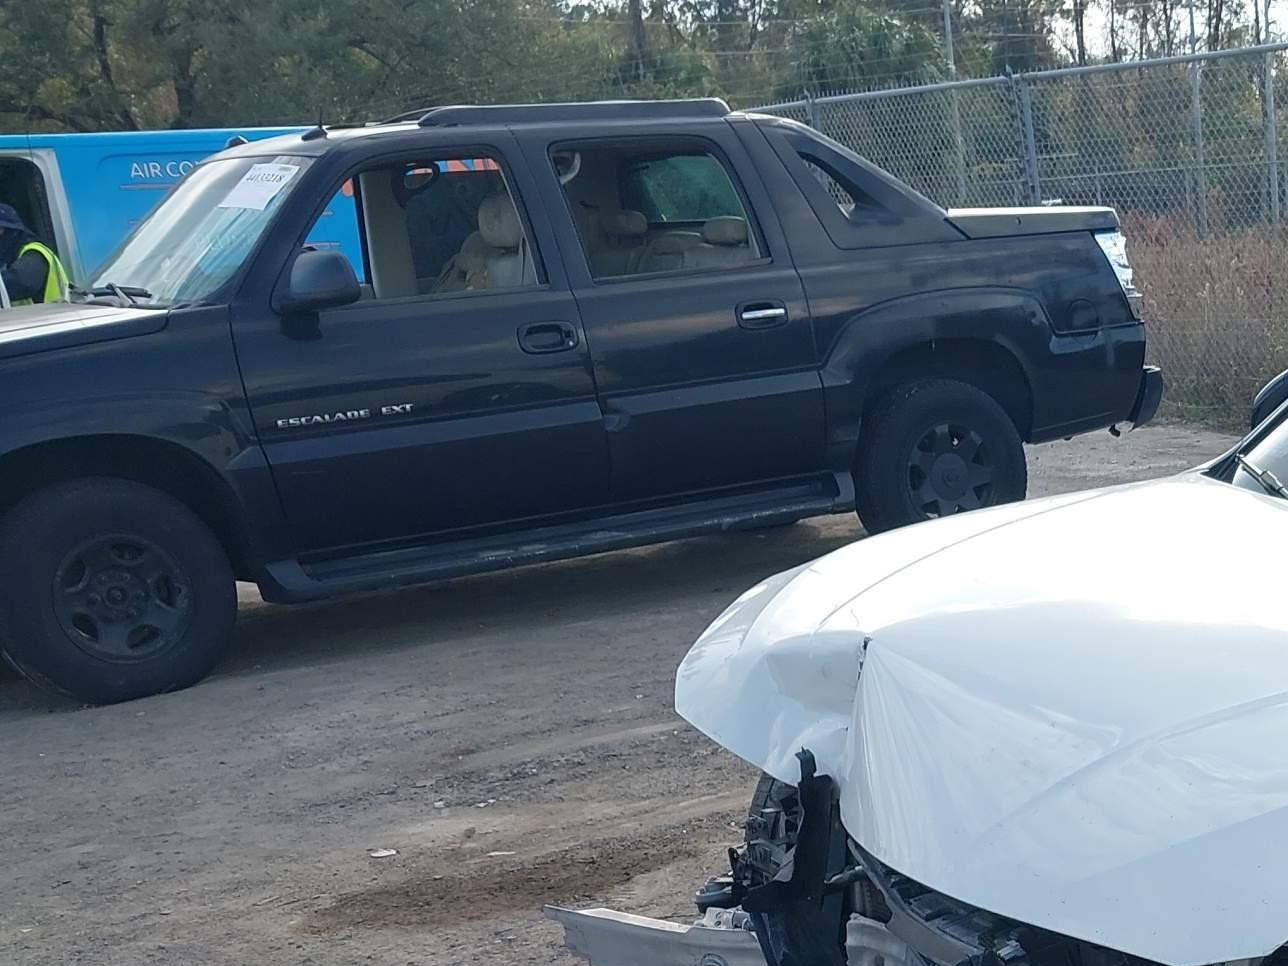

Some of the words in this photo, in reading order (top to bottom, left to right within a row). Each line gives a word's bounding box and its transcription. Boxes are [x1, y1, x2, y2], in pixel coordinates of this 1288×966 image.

[130, 162, 163, 179] AIR
[166, 160, 200, 177] CO
[277, 409, 370, 428] ESCALADE
[381, 403, 414, 416] EXT
